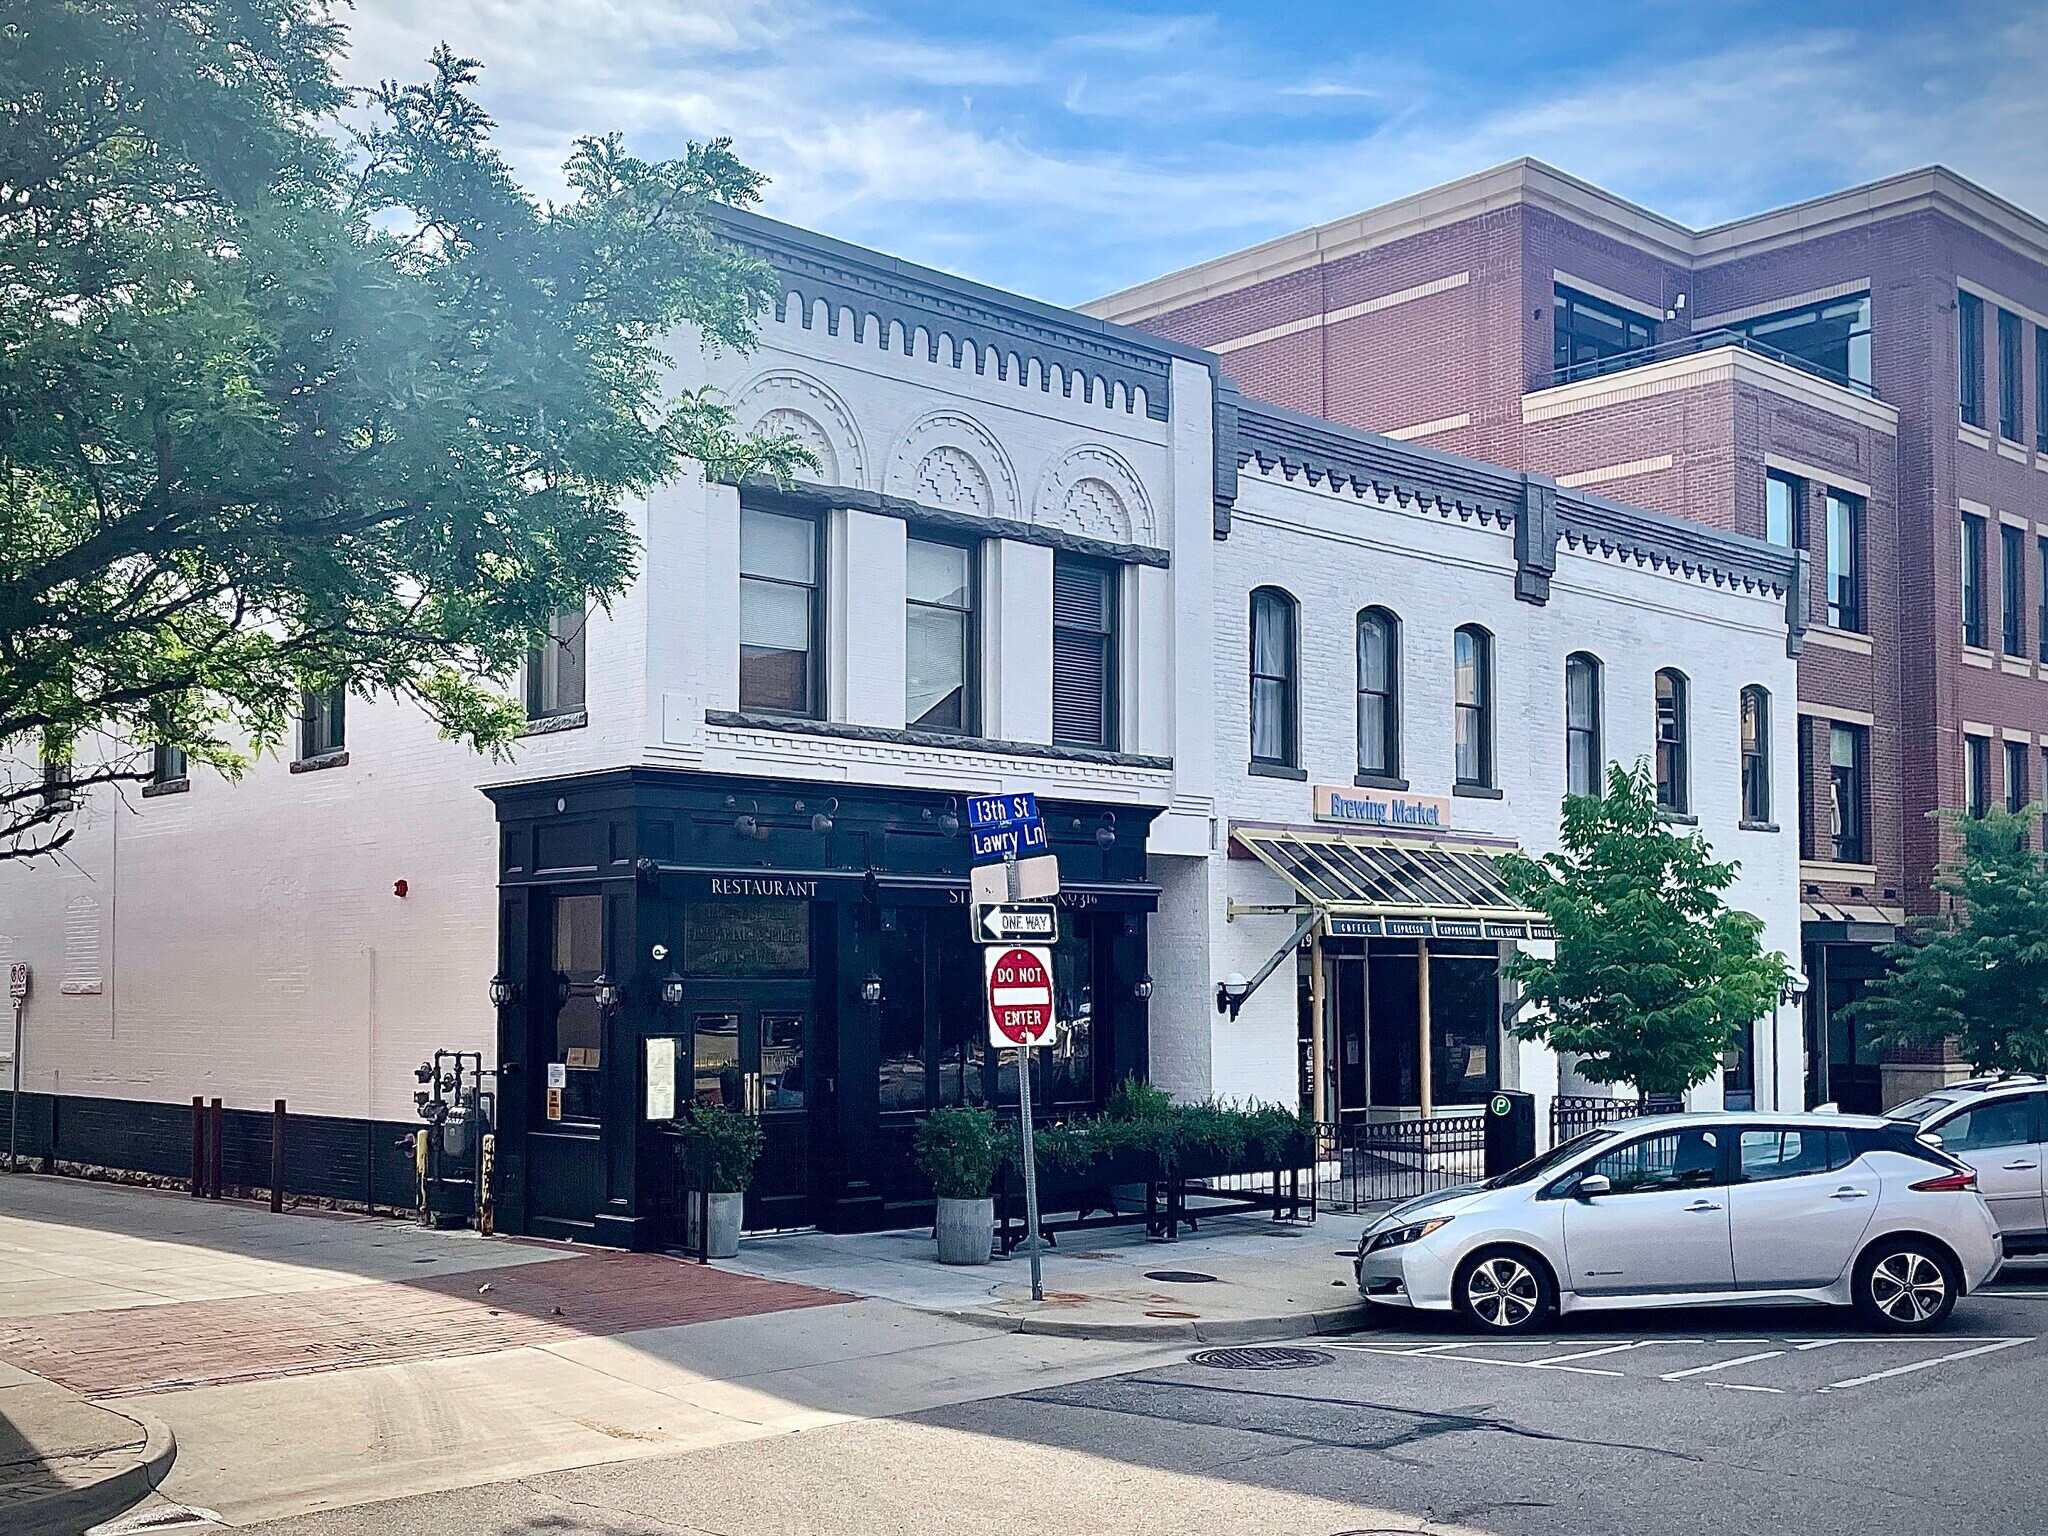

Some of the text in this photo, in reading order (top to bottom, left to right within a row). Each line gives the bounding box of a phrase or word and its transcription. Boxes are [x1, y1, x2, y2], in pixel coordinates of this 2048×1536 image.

[976, 797, 1030, 823] 13th St
[1331, 793, 1440, 825] Brewing Market
[974, 823, 1043, 855] Lawry Ln
[712, 878, 819, 897] RESTAURANT
[1002, 915, 1048, 931] ONE WAY
[1341, 923, 1372, 933] COFFEE
[1392, 924, 1424, 934] ESPRESSO
[997, 967, 1041, 983] DO NOT
[1004, 1010, 1041, 1026] ENTER
